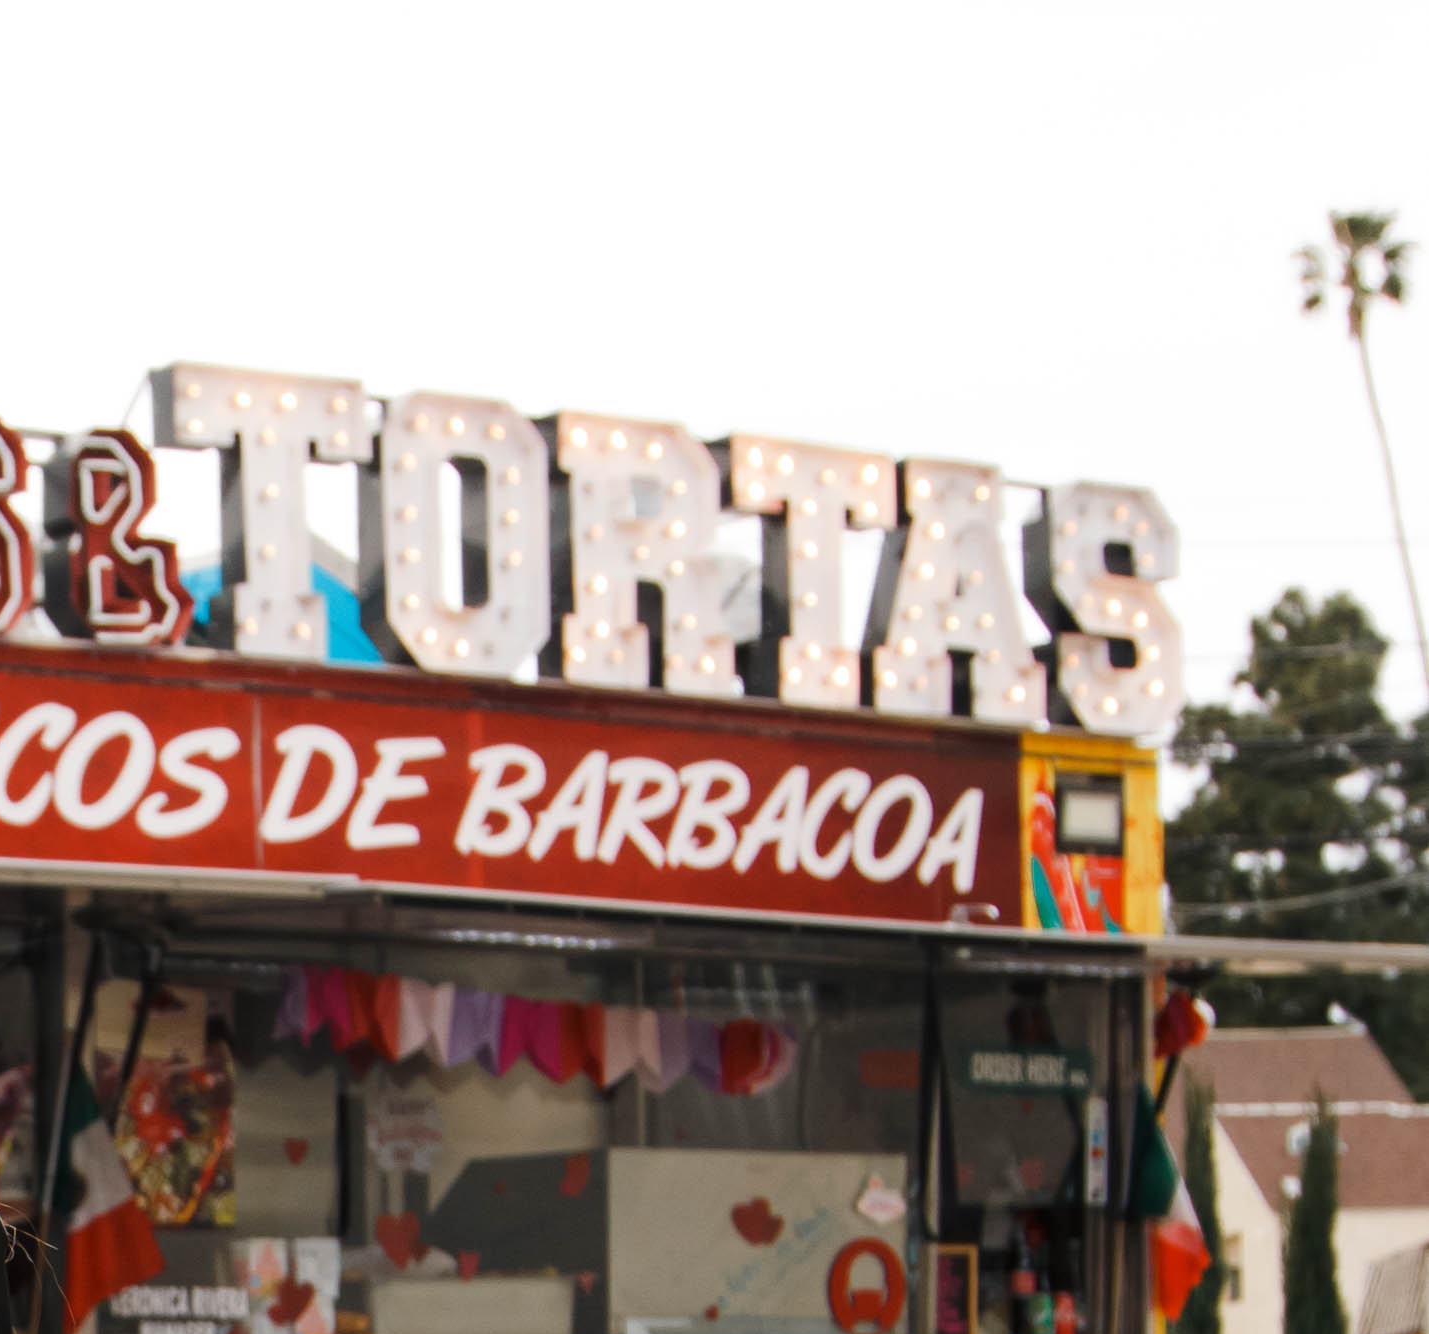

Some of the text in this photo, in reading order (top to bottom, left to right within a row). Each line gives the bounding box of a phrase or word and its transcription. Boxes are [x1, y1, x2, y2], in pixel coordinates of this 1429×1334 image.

[70, 428, 195, 646] &
[154, 362, 1182, 741] TORTAS
[260, 724, 446, 852] DE
[454, 742, 984, 892] BARBACOA
